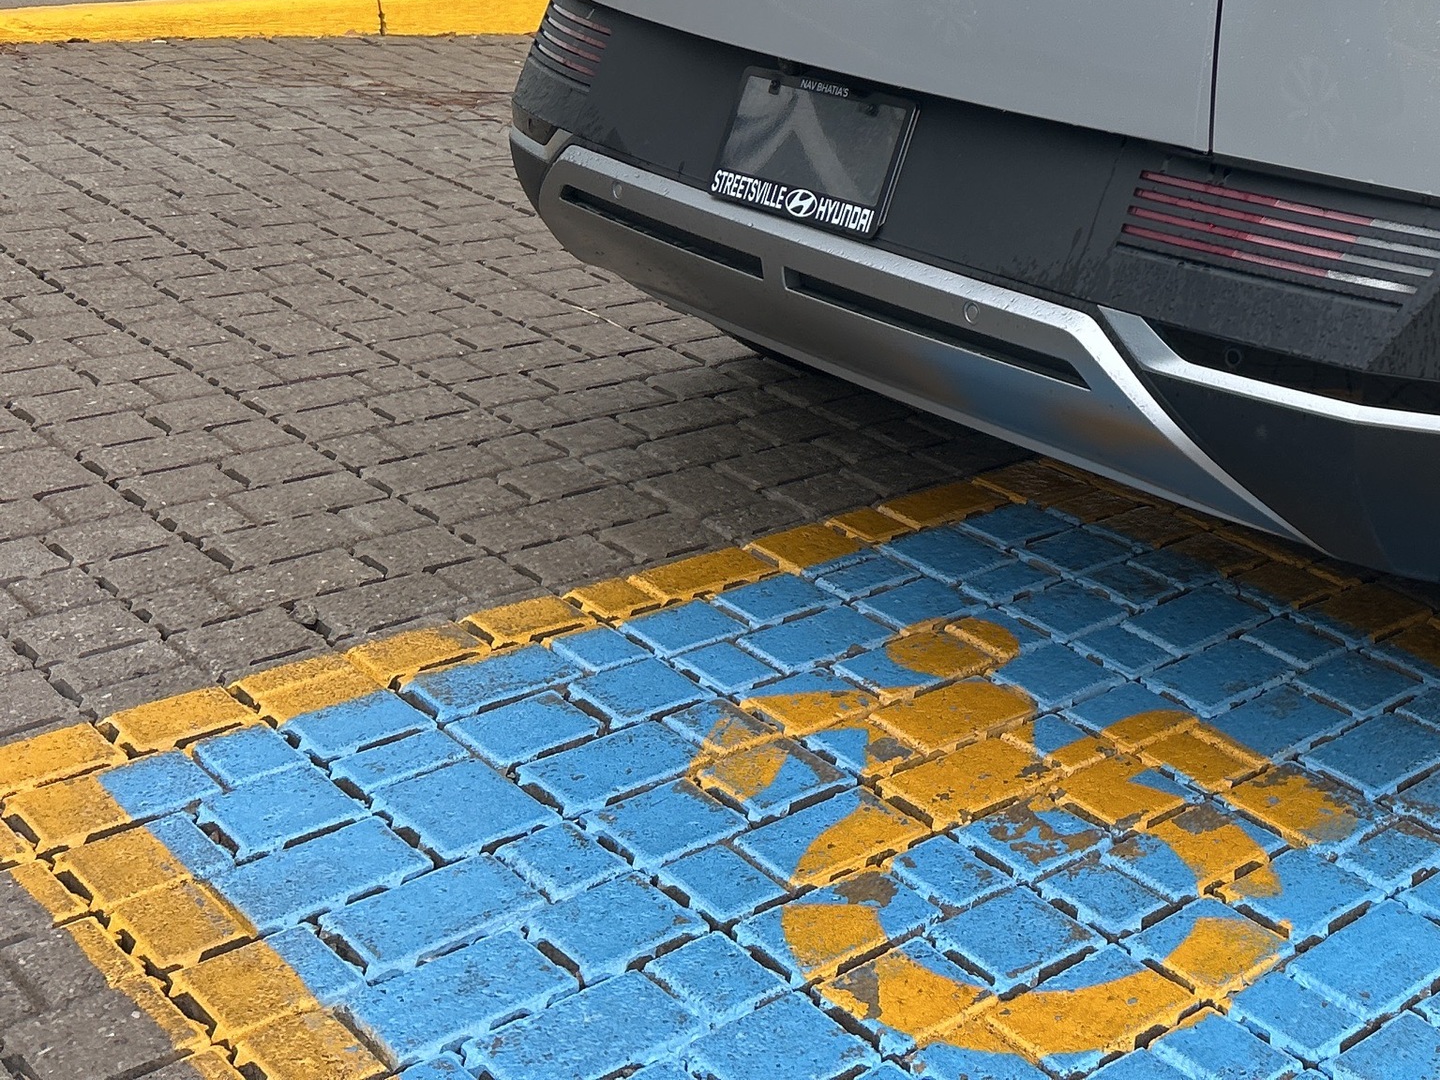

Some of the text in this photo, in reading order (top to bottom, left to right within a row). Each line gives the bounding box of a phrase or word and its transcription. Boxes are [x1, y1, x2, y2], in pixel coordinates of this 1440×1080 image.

[800, 78, 850, 97] NAV BHATIA'S
[711, 169, 875, 233] STREETSVILLE HYUNDAI
